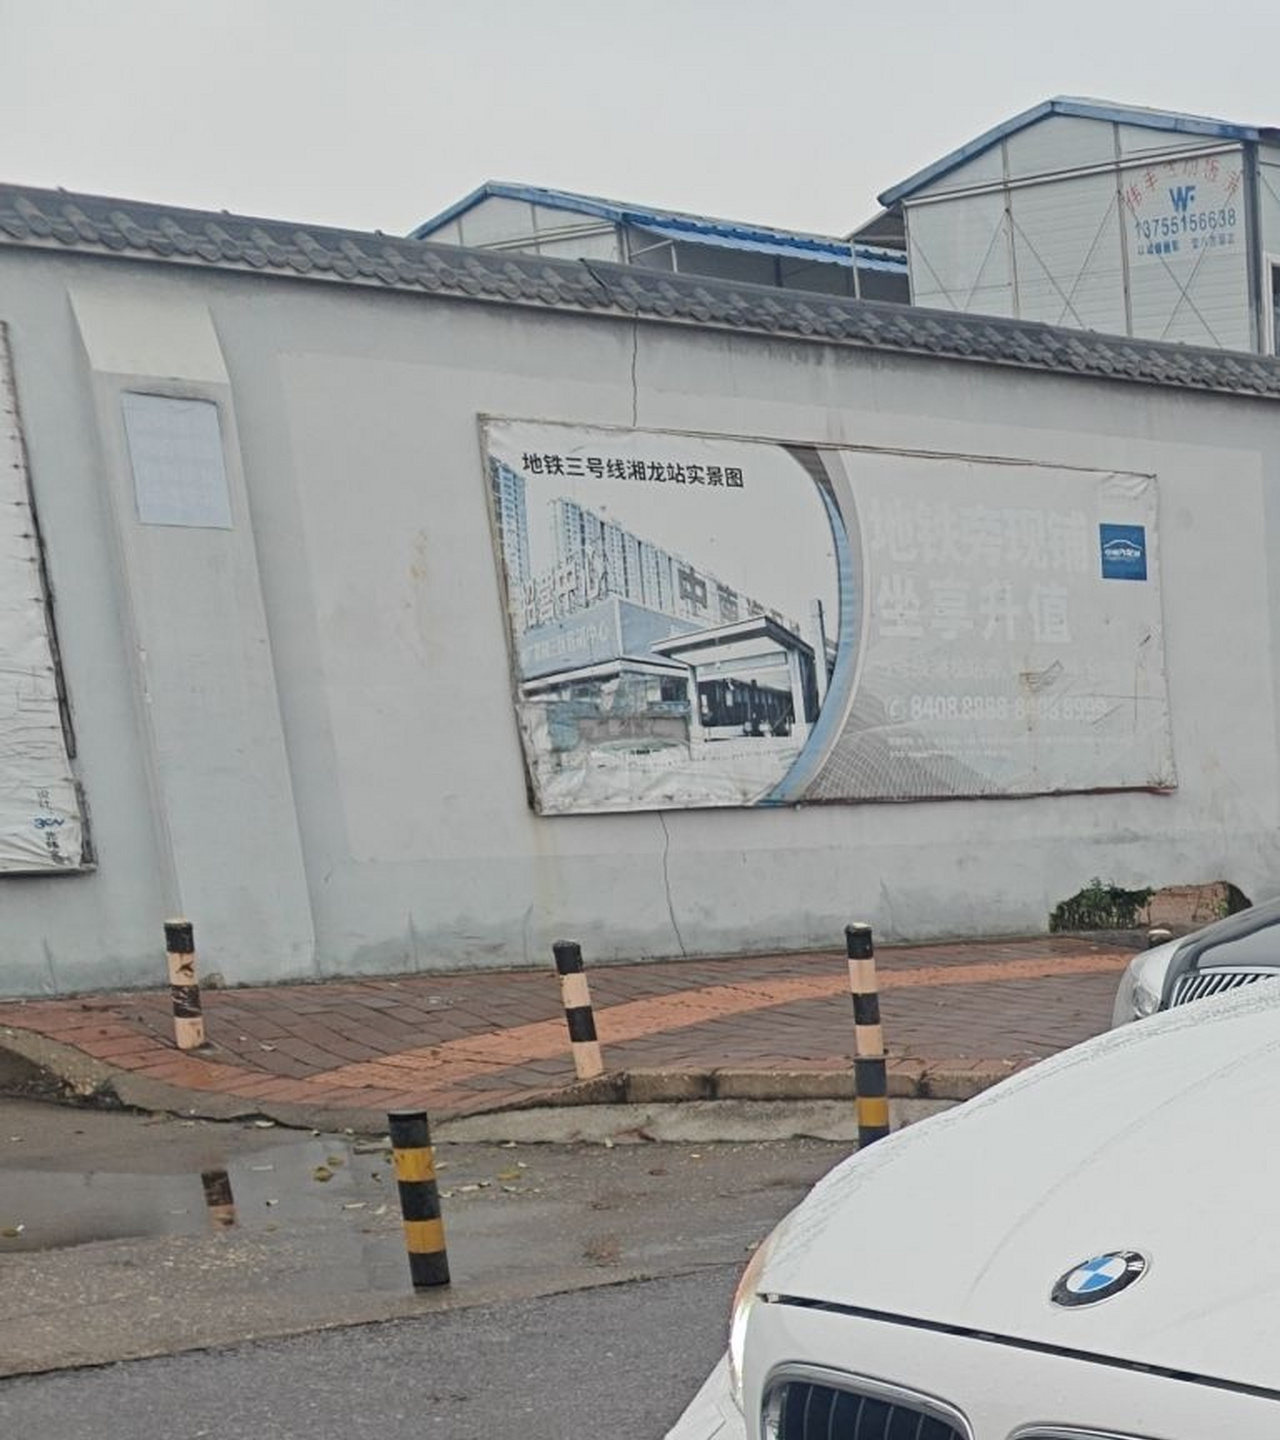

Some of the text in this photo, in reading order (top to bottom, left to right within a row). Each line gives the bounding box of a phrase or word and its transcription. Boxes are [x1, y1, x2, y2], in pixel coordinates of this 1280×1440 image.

[1134, 207, 1237, 240] 13755156638
[522, 452, 744, 488] 地铁三号线湘龙站实景图
[877, 573, 1072, 643] 坐享升值
